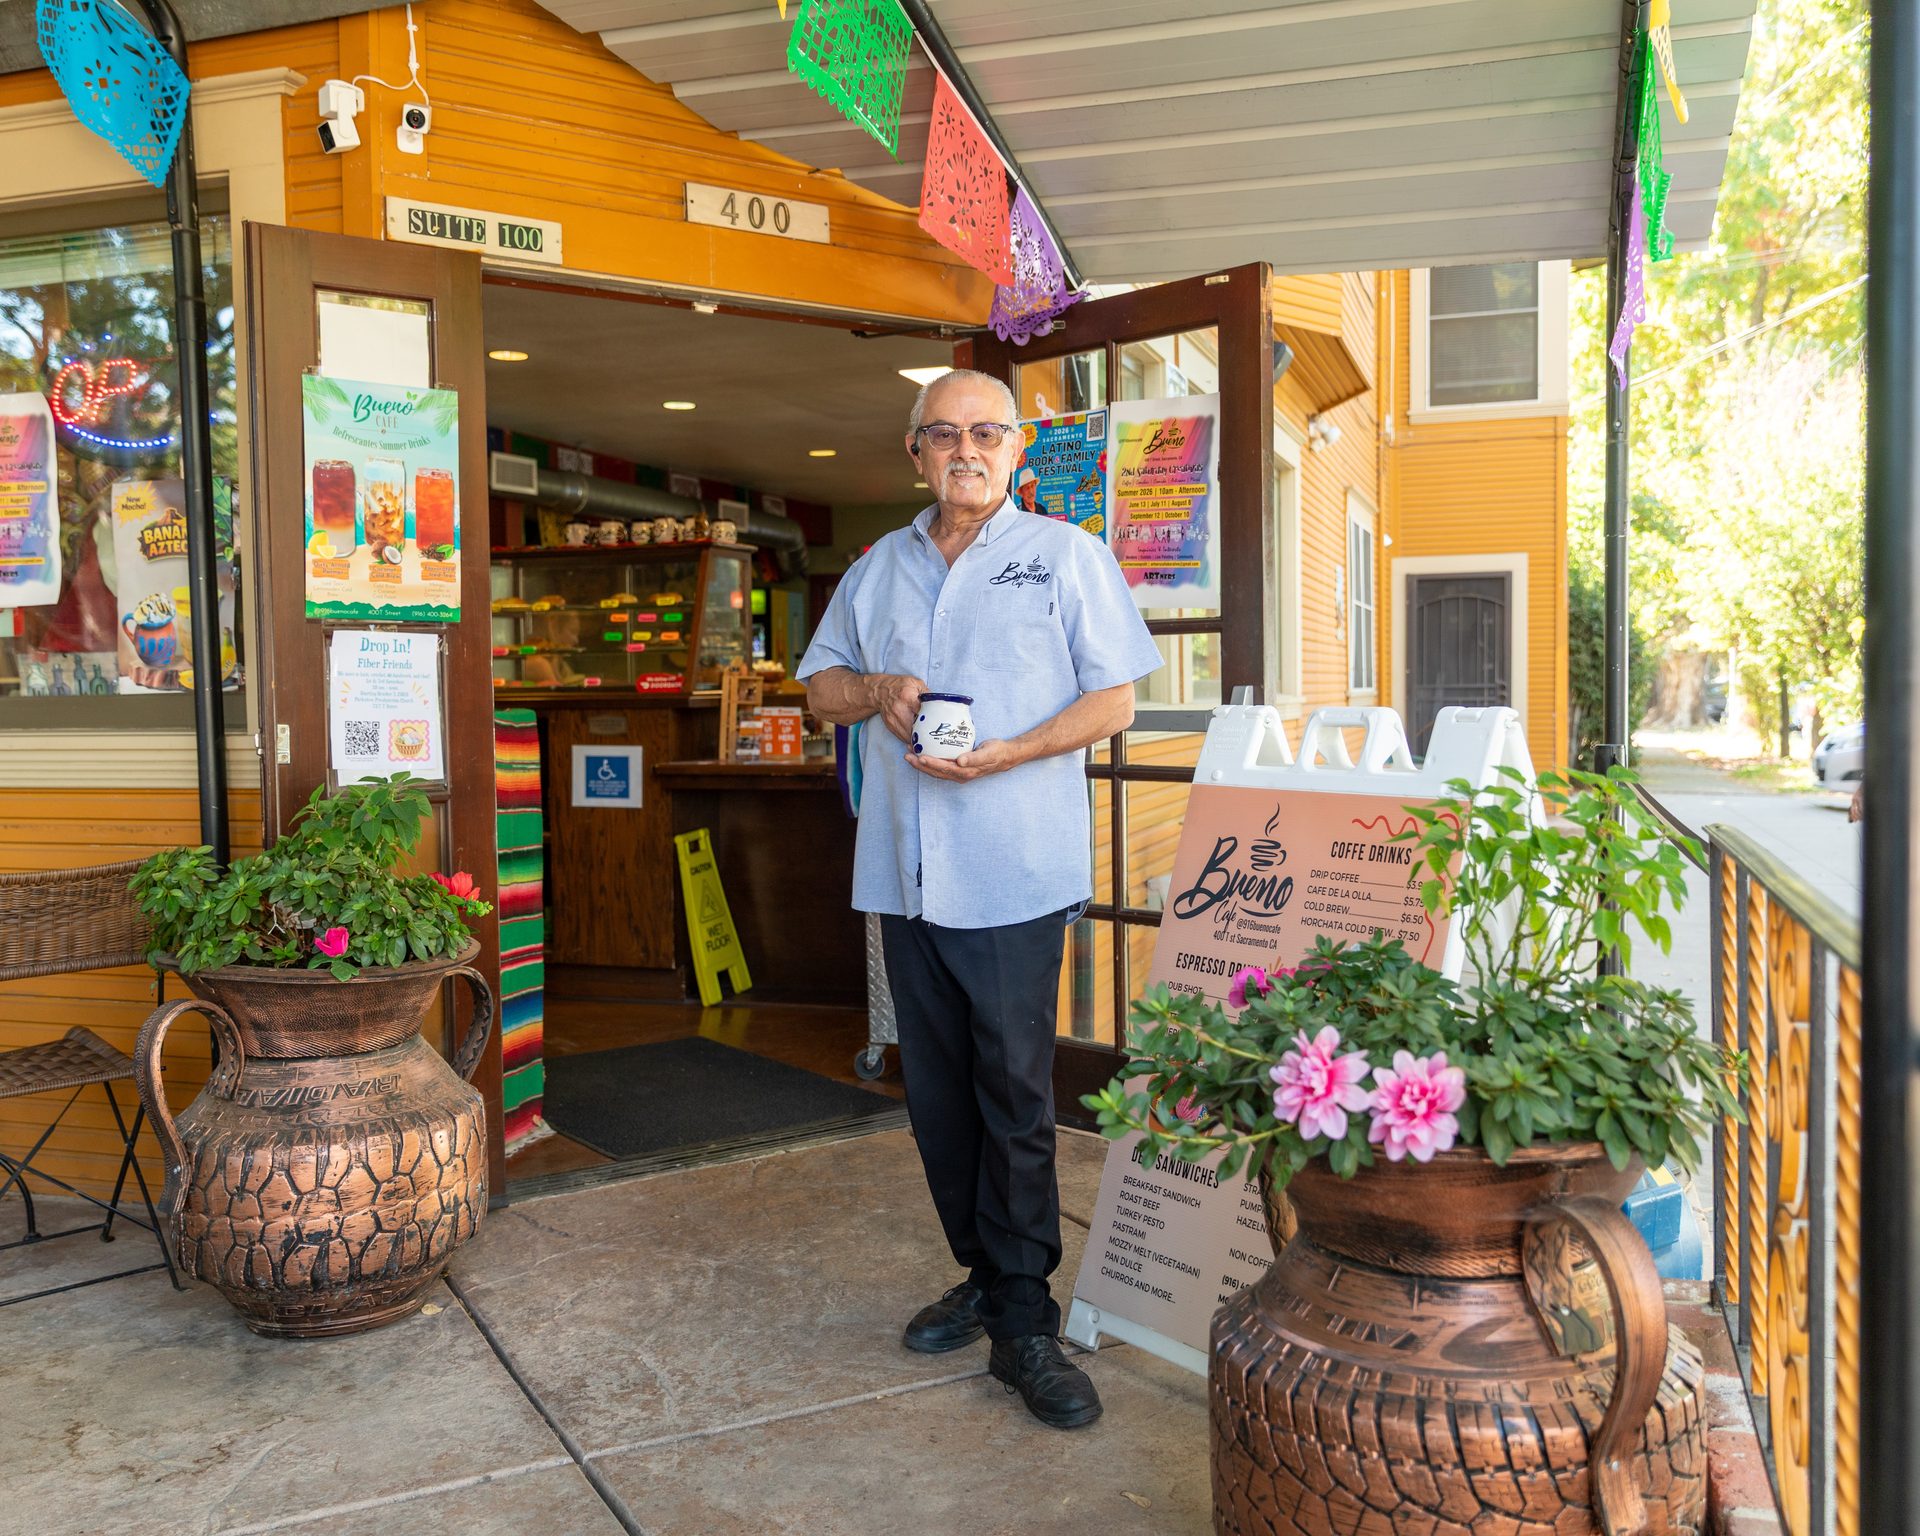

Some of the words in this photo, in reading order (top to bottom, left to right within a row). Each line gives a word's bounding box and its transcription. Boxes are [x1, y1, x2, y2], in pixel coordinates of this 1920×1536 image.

[721, 193, 790, 233] 400
[409, 208, 486, 244] SUITE
[500, 223, 542, 252] 100
[353, 393, 416, 423] Bueno
[333, 426, 378, 449] Refrescantes
[379, 440, 407, 451] Summer
[408, 435, 431, 449] Drinks
[1042, 433, 1083, 443] SACRAMENTO
[1042, 441, 1082, 455] LATINO
[1143, 429, 1186, 455] Bueno
[1028, 455, 1054, 467] BOOK
[1060, 450, 1096, 463] FAMILY
[1038, 463, 1084, 477] FESTIVAL
[17, 483, 45, 492] Afternoon
[1117, 489, 1139, 497] Summer
[1159, 487, 1174, 495] 10am
[1178, 486, 1206, 494] Afternoon
[4, 509, 21, 517] October
[121, 503, 147, 511] Mocha!
[1150, 500, 1160, 508] July
[1171, 499, 1187, 507] August
[1130, 512, 1154, 520] September
[1164, 511, 1182, 519] October
[143, 525, 188, 545] BANAN
[149, 540, 188, 557] AZTEC
[989, 561, 1051, 586] Bueno
[1012, 578, 1024, 588] Cafe
[361, 637, 389, 655] Drop
[393, 638, 412, 654] In!
[357, 658, 381, 669] Fiber
[382, 659, 413, 670] Friends
[1331, 841, 1366, 861] COFFE
[1368, 844, 1413, 866] DRINKS
[1174, 836, 1294, 920] Bueno
[1310, 869, 1329, 879] DRIP
[1330, 871, 1360, 883] COFFEE
[1406, 880, 1424, 890] $3.9
[1307, 885, 1327, 896] CAFE
[1328, 887, 1339, 897] DE
[1340, 889, 1350, 899] LA
[1351, 890, 1372, 901] OLLA
[1214, 899, 1239, 933] Cafe
[1303, 900, 1325, 912] COLD
[1400, 911, 1424, 925] $6.50
[707, 922, 724, 938] WET
[1236, 918, 1281, 934] @916buenocafe
[1300, 916, 1343, 931] HORCHATA
[1345, 922, 1370, 934] COLD
[1398, 929, 1420, 942] $7.50
[705, 934, 731, 952] FLOOR
[1213, 930, 1225, 941] 400
[1225, 932, 1230, 941] T
[1230, 933, 1236, 943] st
[1236, 933, 1269, 949] Sacramento
[1269, 938, 1278, 950] CA
[1175, 952, 1226, 976] ESPRESSO
[1168, 981, 1183, 992] DUB
[1155, 1153, 1219, 1189] SANDWICHES
[1123, 1175, 1162, 1196] BREAKFAST
[1162, 1188, 1201, 1208] SANDWICH
[1243, 1182, 1261, 1196] STRA
[1119, 1190, 1143, 1205] ROAST
[1143, 1198, 1161, 1211] BEEF
[1240, 1199, 1265, 1215] PUMP
[1116, 1205, 1142, 1221] TURKEY
[1142, 1214, 1165, 1230] PESTO
[1236, 1215, 1269, 1235] HAZELN
[1112, 1220, 1147, 1240] PASTRAMI
[1104, 1250, 1120, 1263] PAN
[1120, 1256, 1143, 1273] DULCE
[1108, 1235, 1134, 1251] MOZZY
[1133, 1244, 1152, 1258] MELT
[1151, 1251, 1201, 1279] (VEGETARIAN)
[1229, 1247, 1247, 1262] NON
[1247, 1254, 1273, 1271] COFFE
[1100, 1266, 1134, 1287] CHURROS
[1134, 1280, 1151, 1293] AND
[1222, 1274, 1239, 1290] (916)
